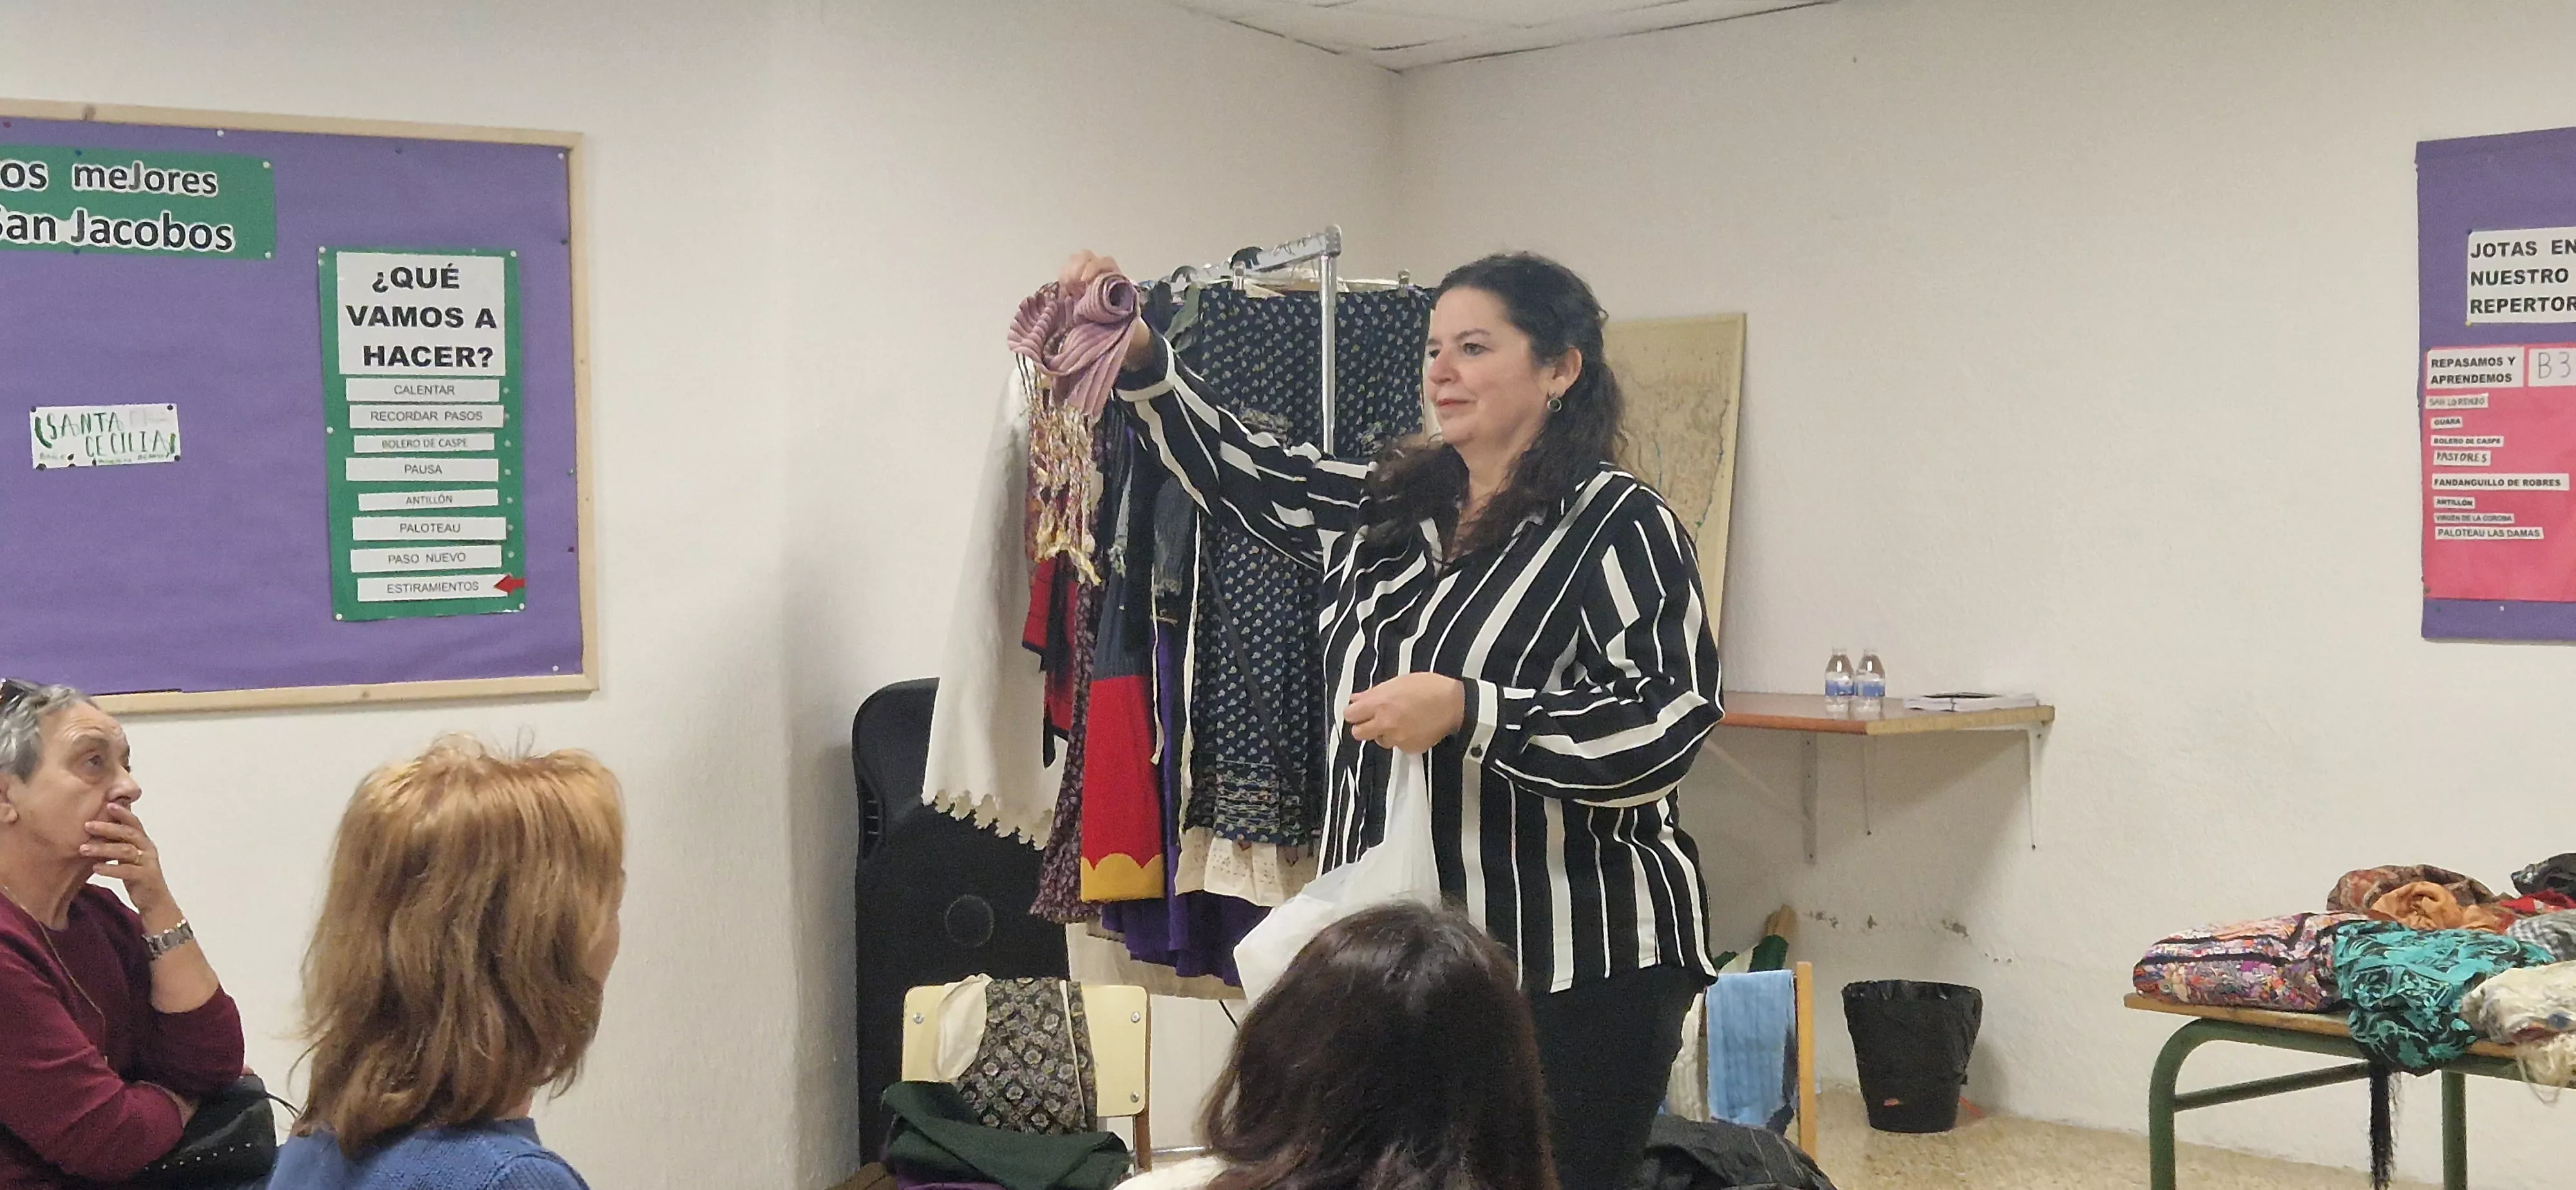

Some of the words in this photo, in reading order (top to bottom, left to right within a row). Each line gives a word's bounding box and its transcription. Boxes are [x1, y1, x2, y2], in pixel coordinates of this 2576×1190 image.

[0, 207, 56, 241] an
[70, 210, 232, 250] Jacobos
[2470, 240, 2537, 258] JOTAS
[372, 263, 460, 293] ¿QUÉ
[2470, 268, 2569, 286] NUESTRO
[346, 305, 464, 328] VAMOS
[475, 308, 497, 329] A
[363, 345, 493, 368] HACER?
[2431, 357, 2503, 368] REPASAMOS
[2507, 356, 2516, 366] Y
[2430, 373, 2512, 384] APRENDEMOS
[393, 384, 455, 395] CALENTAR
[370, 410, 438, 422] RECORDAR
[444, 410, 483, 420] PASOS
[46, 412, 124, 439] SANTA
[381, 439, 421, 449] BOLERO
[423, 438, 434, 448] DE
[439, 438, 468, 448] CASPE
[404, 464, 443, 475] PAUSA
[2434, 478, 2505, 487] FANDANGUILLO
[405, 494, 453, 505] ANTILLÓN
[399, 523, 461, 533] PALOTEAU
[2438, 528, 2485, 536] PALOTEAU
[388, 554, 419, 564] PASO
[426, 552, 466, 563] NUEVO
[386, 581, 479, 594] ESTIRAMIENTOS
